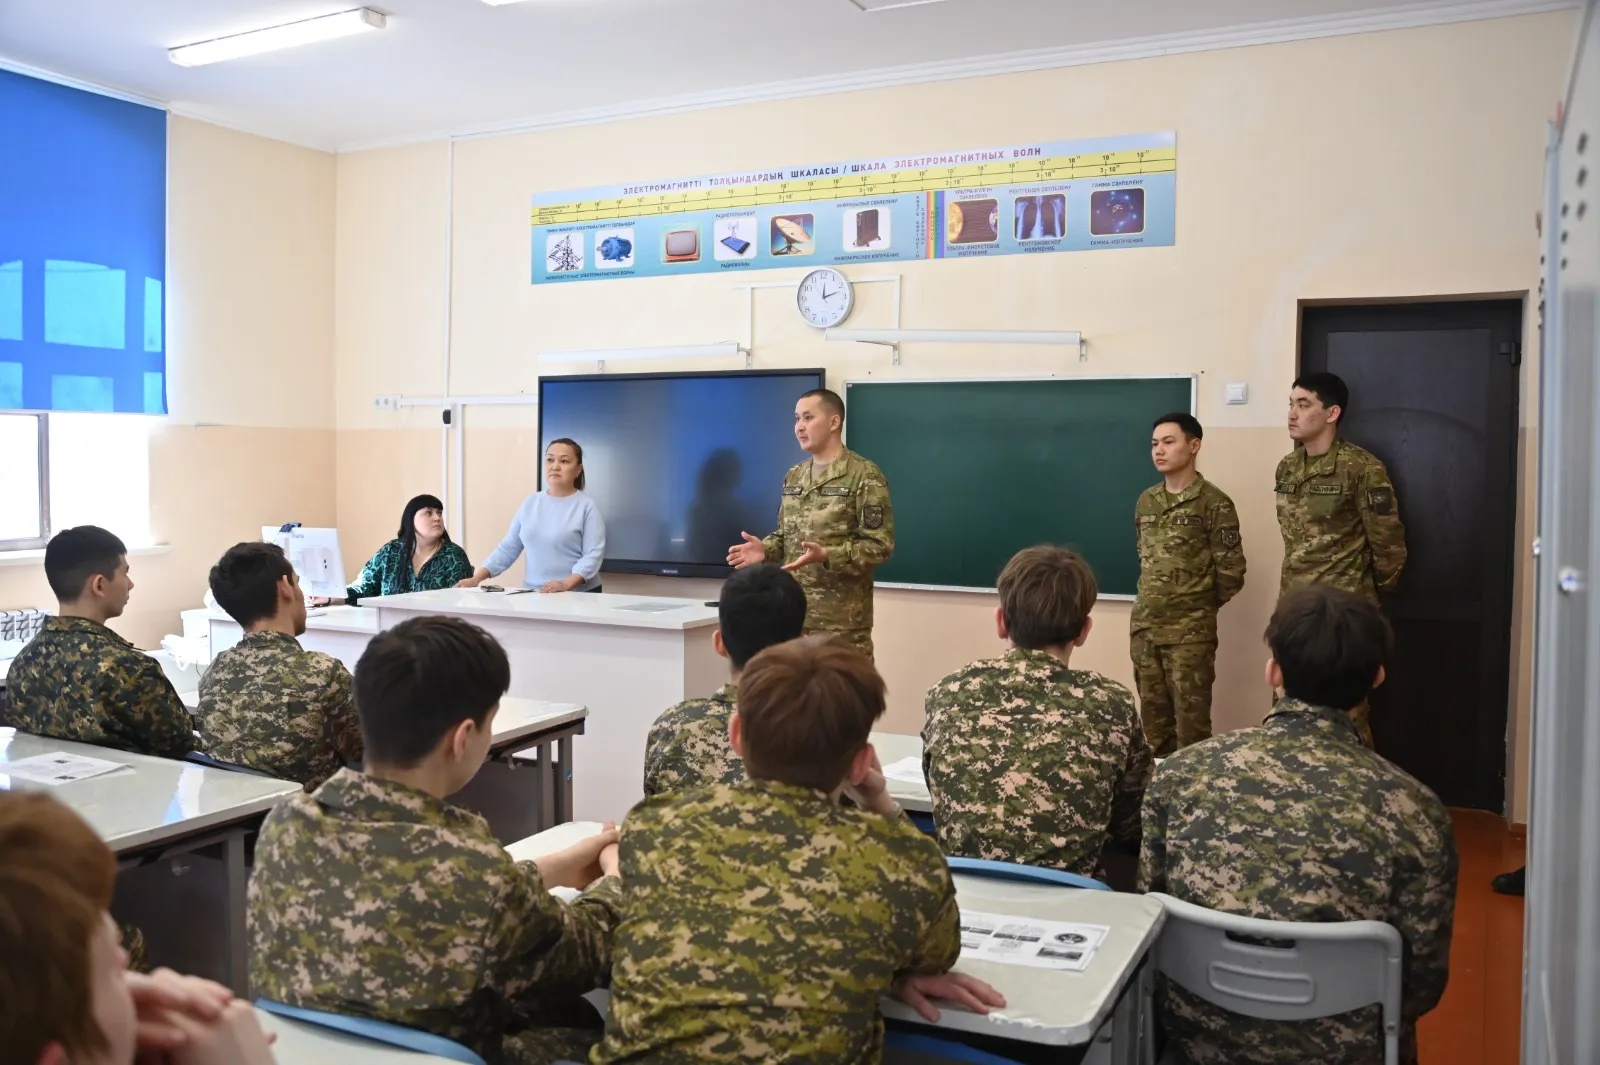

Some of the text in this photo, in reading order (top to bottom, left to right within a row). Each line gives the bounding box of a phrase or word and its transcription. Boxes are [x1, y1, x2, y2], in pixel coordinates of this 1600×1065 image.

[623, 180, 702, 195] ЭЛЕКТРОМАГНИТТІ
[709, 171, 784, 186] ТОЛҚЫНДАРДЫҢ
[790, 166, 839, 178] ШКАЛАСЫ
[851, 162, 887, 173] ШКАЛА
[894, 150, 1004, 168] ЭЛЕКТРОМАГНИТНЫХ
[1013, 147, 1042, 158] ВОЛН
[811, 276, 817, 284] 11
[820, 271, 828, 280] 12
